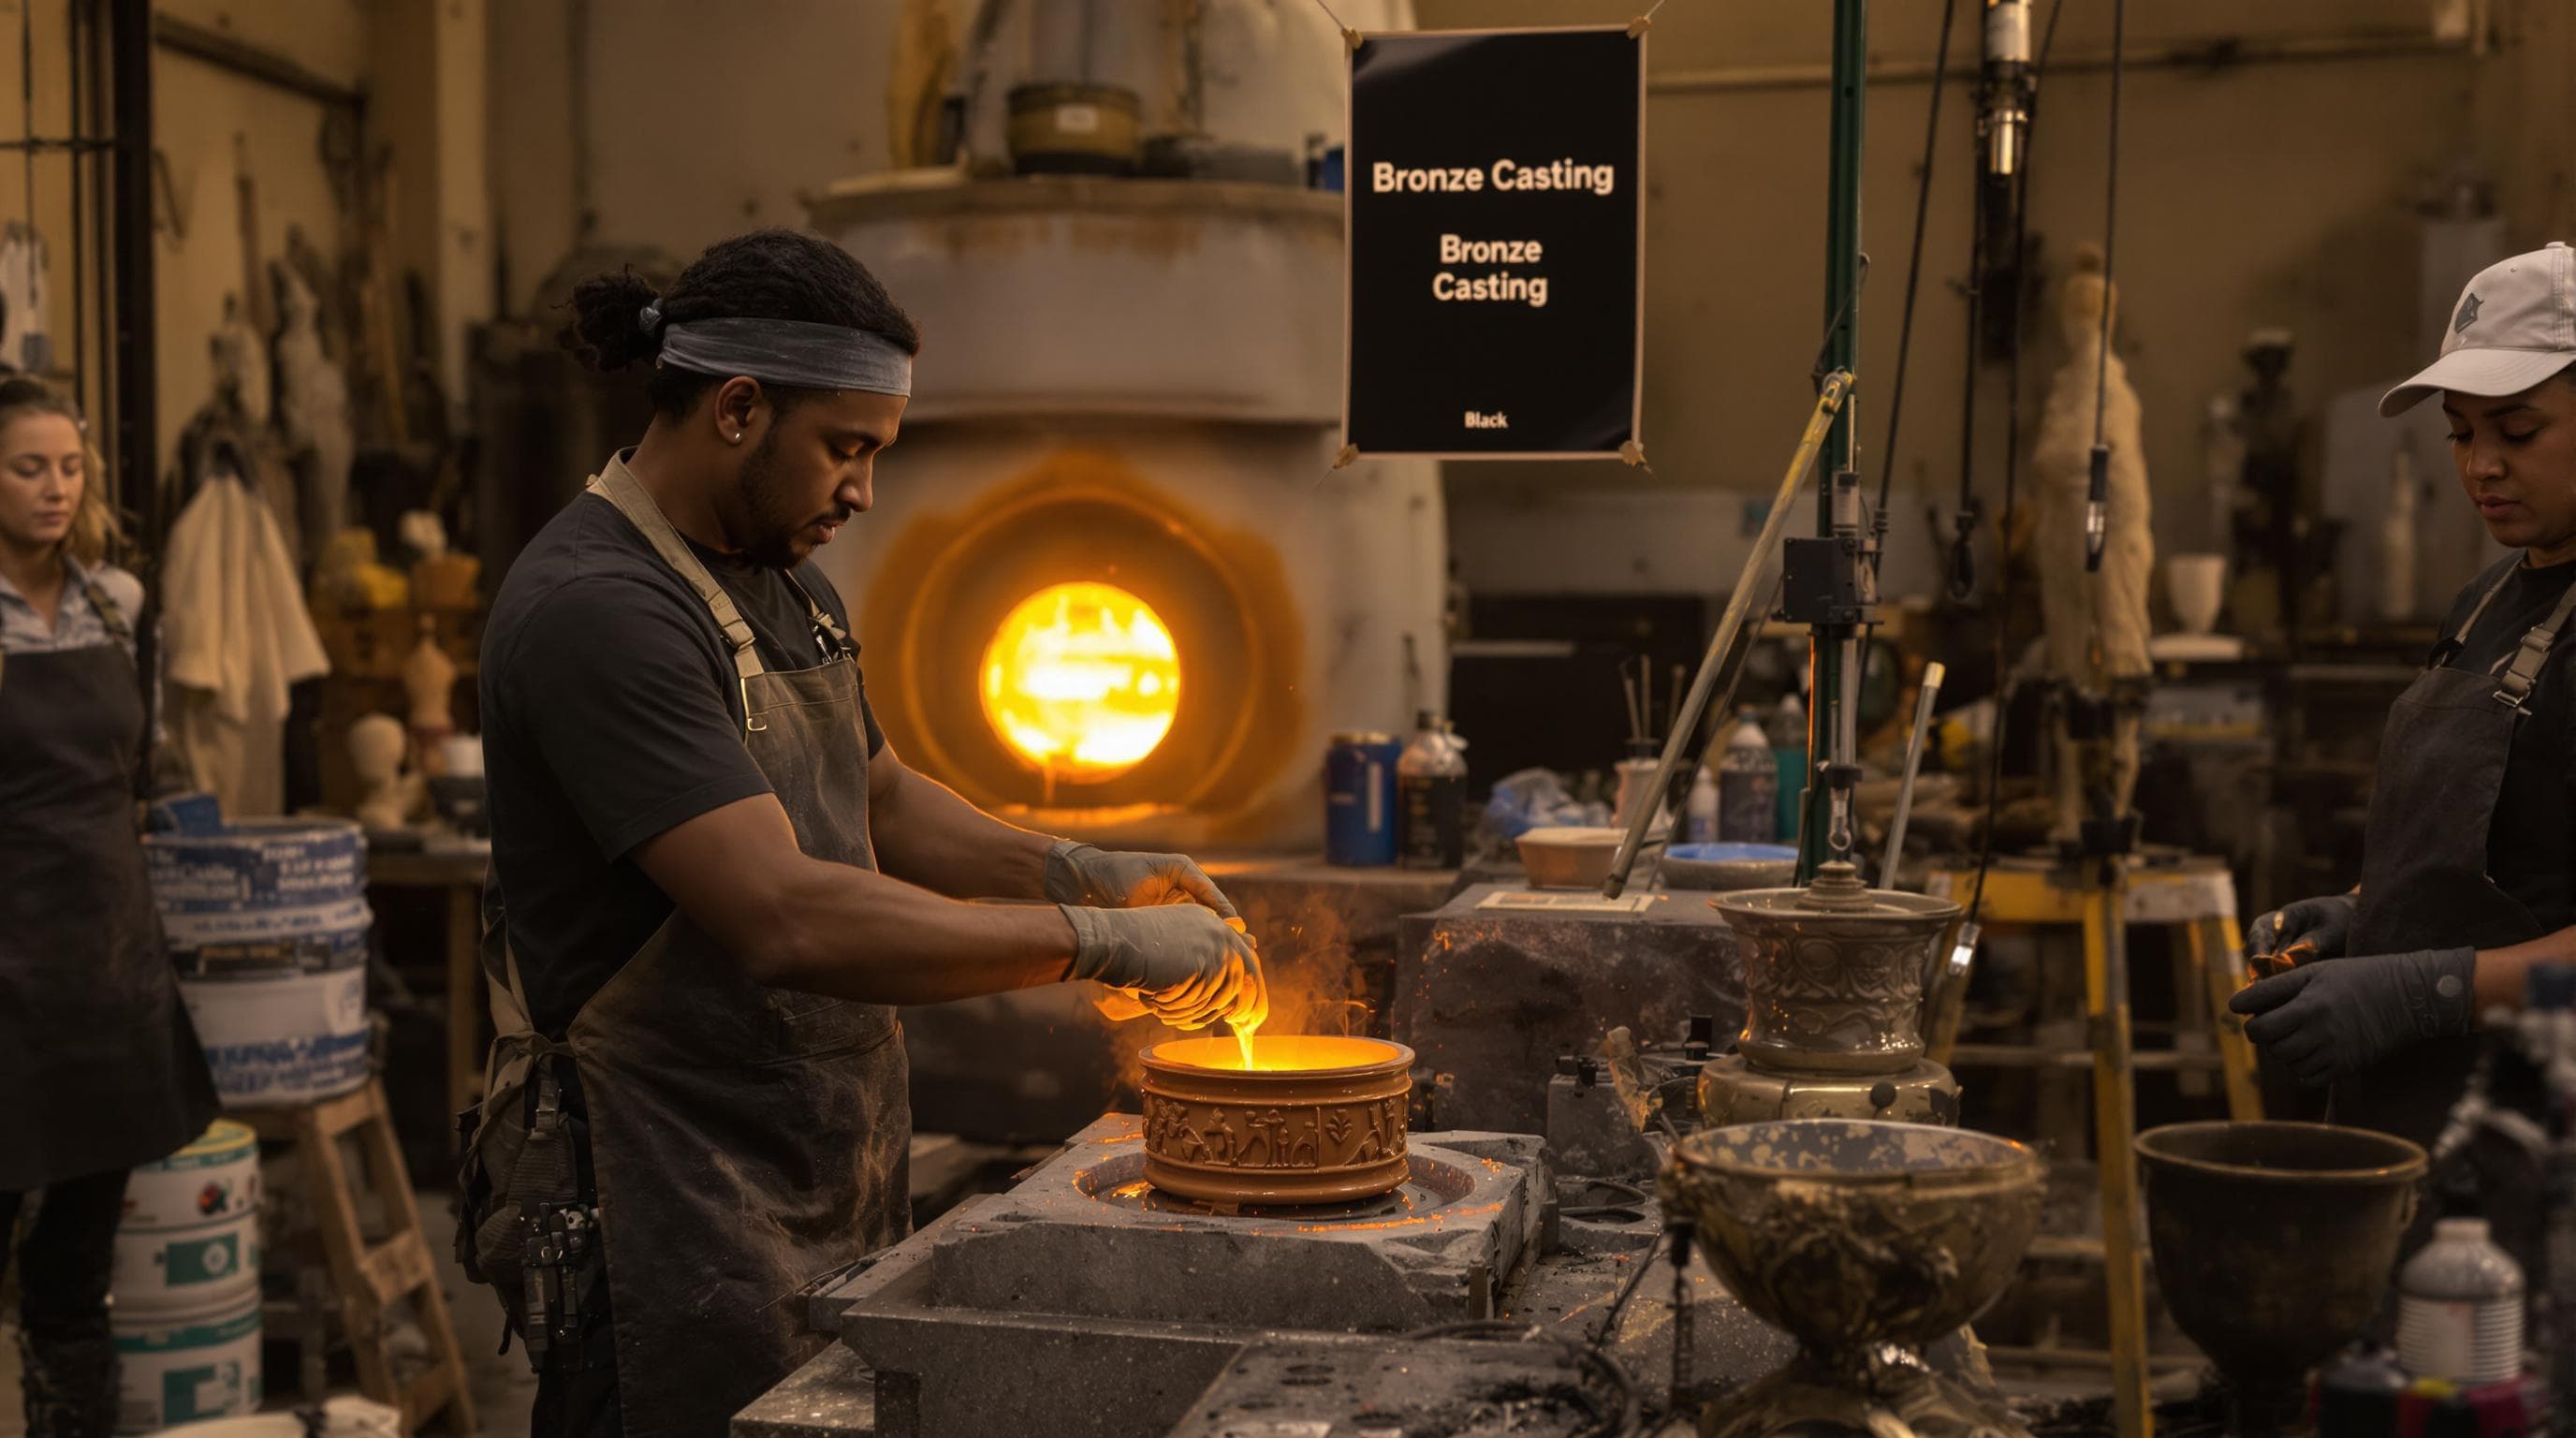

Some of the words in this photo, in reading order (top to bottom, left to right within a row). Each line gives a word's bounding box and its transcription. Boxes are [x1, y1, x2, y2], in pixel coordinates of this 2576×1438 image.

[1372, 161, 1485, 193] Bronze
[1491, 157, 1615, 196] Casting
[1440, 233, 1544, 264] Bronze
[1432, 271, 1549, 308] Casting
[1464, 411, 1509, 429] Black
